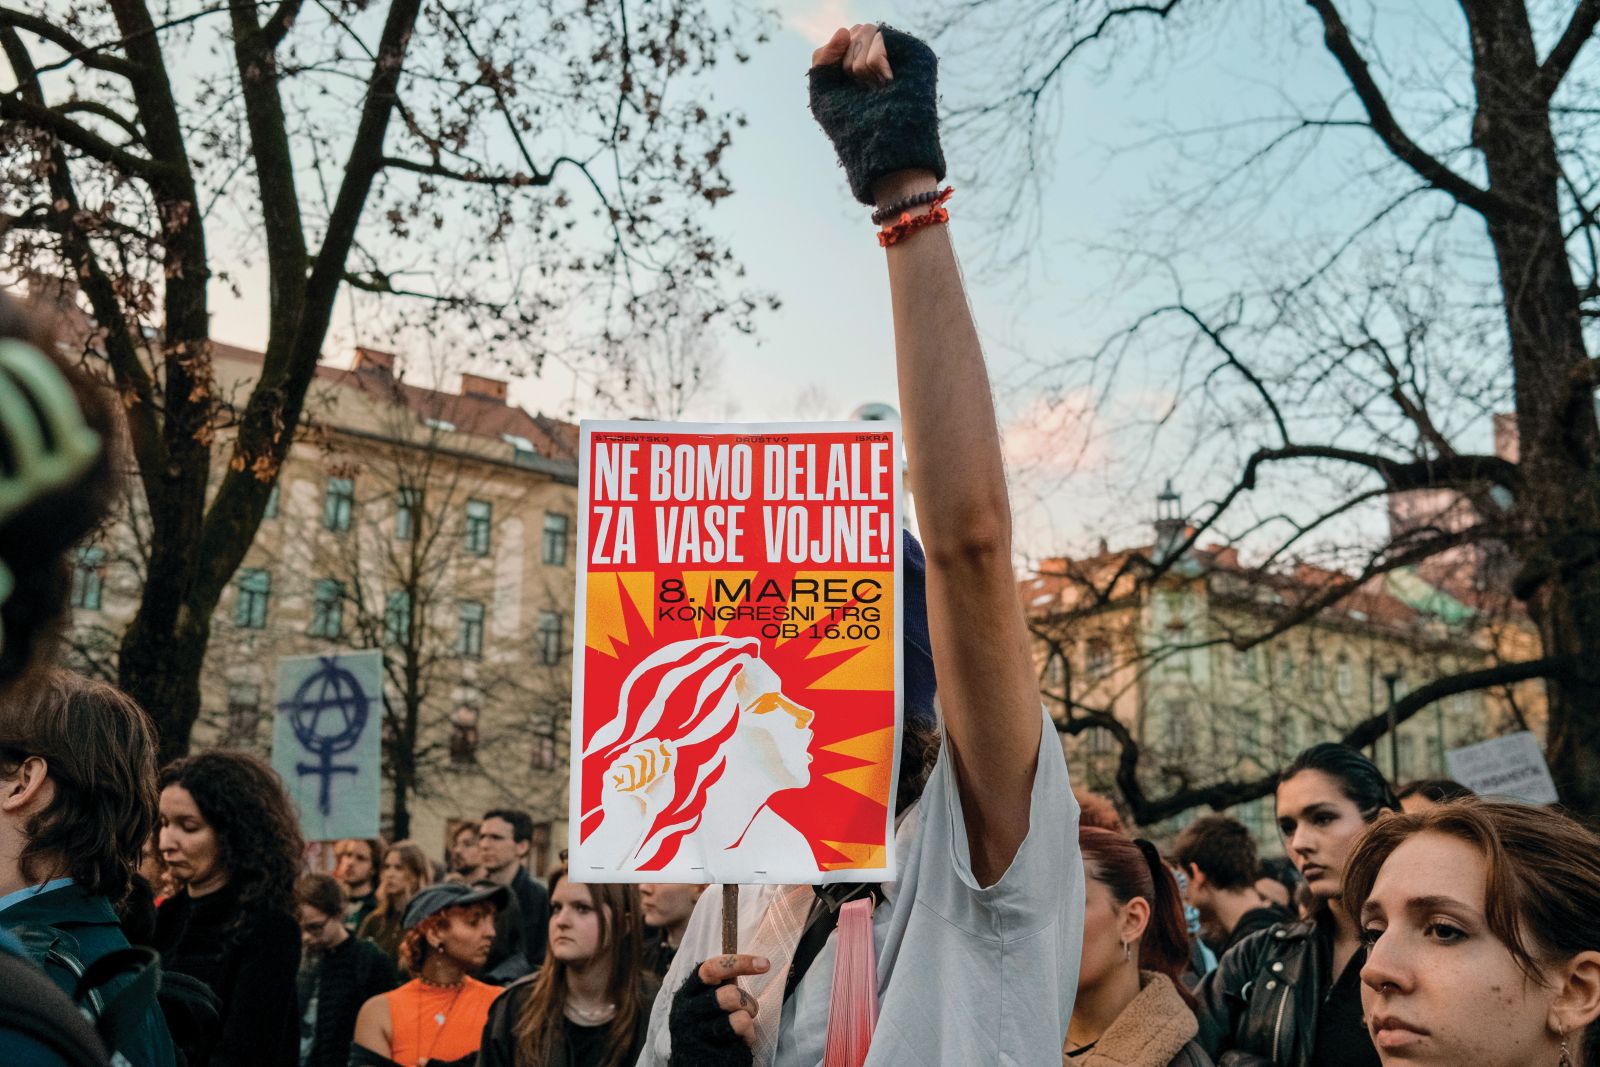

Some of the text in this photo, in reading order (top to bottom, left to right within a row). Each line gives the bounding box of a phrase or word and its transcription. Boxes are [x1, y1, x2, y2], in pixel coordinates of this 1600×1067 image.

[855, 434, 889, 442] ISKRA
[594, 442, 889, 502] NE BOMO DELALE
[592, 506, 637, 564] ZA
[763, 505, 890, 564] VOJNE!
[659, 578, 882, 603] 8. MAREC
[659, 606, 880, 622] KONGRESNI TRG
[761, 623, 880, 640] OB 16.00
